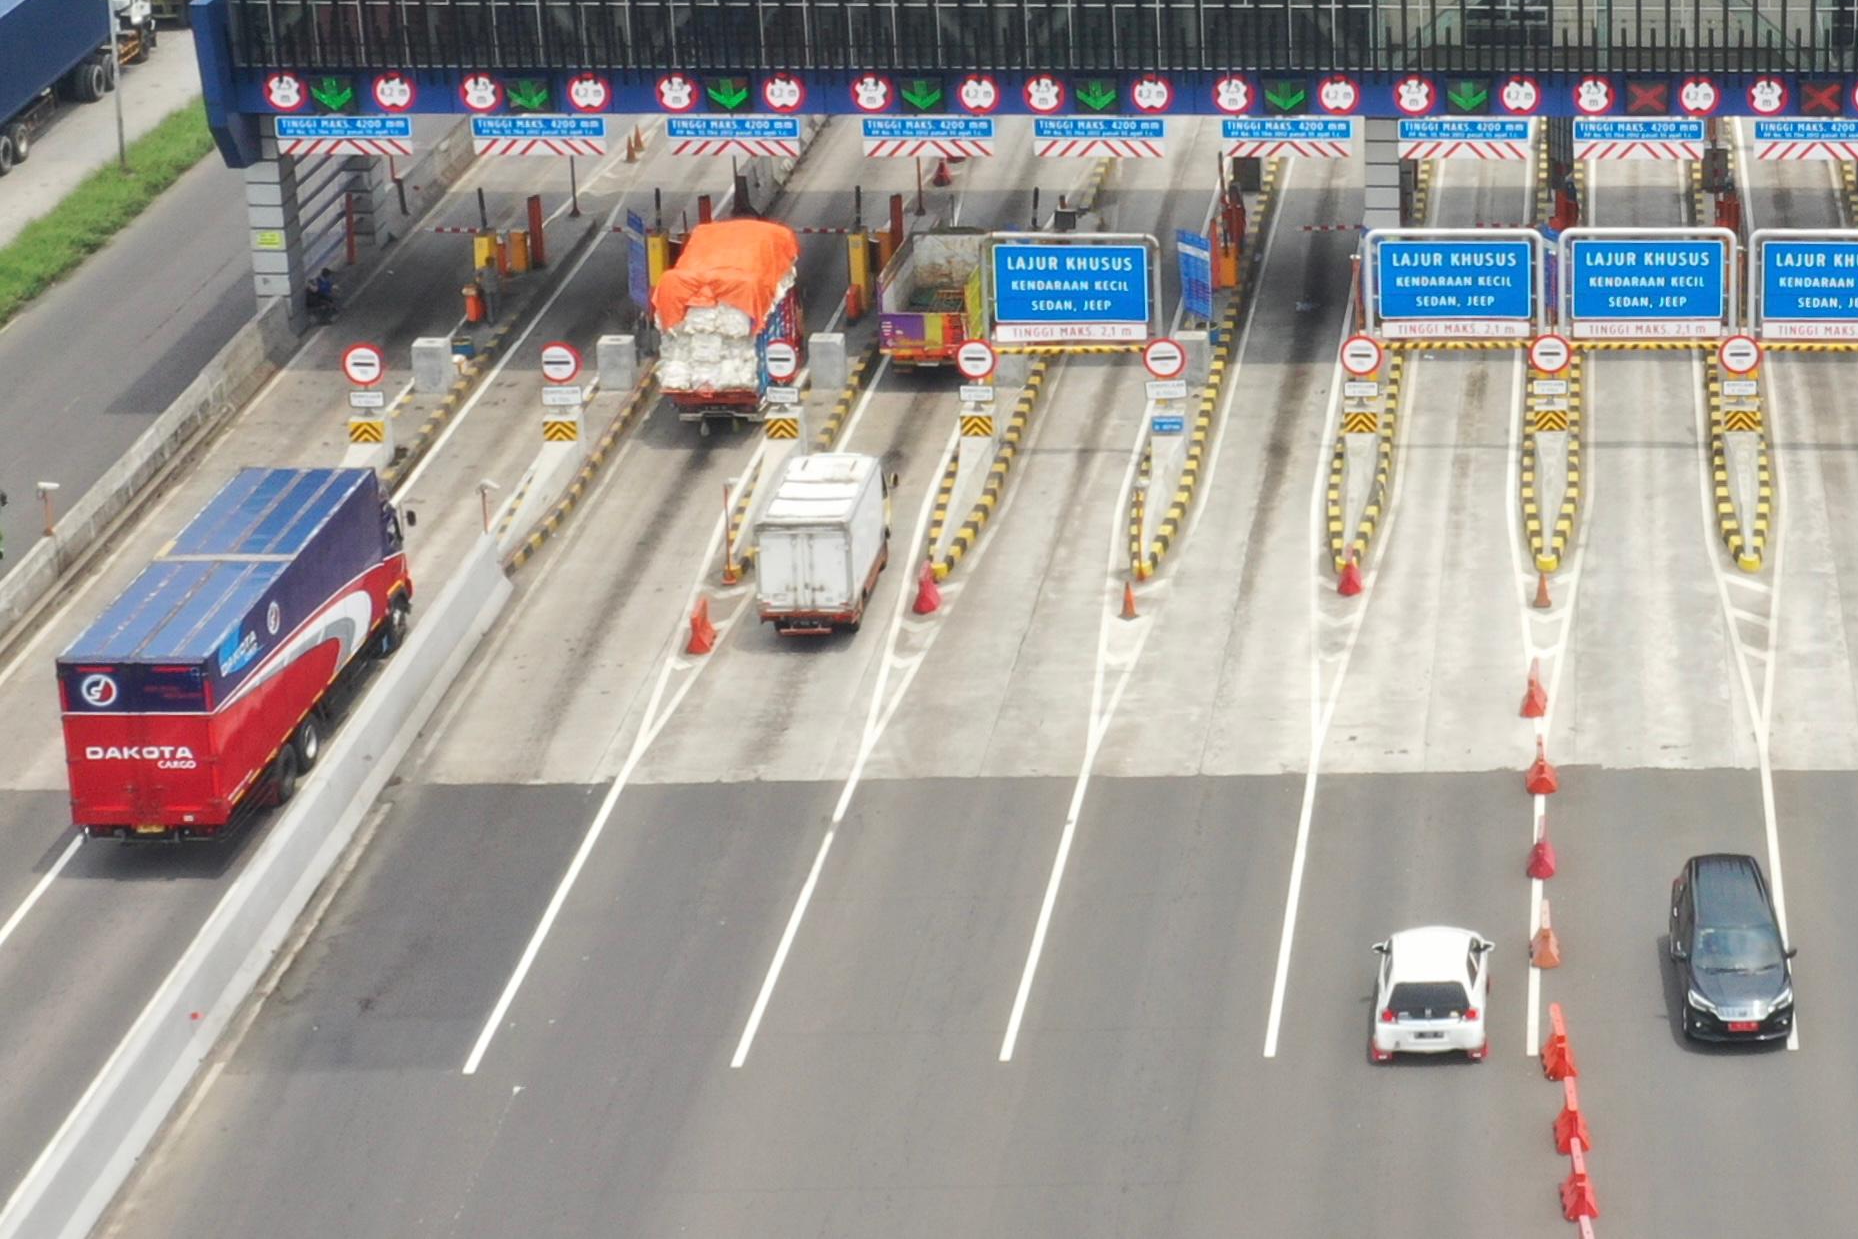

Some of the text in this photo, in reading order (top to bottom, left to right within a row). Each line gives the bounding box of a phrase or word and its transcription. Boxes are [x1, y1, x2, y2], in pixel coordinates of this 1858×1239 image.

[1155, 90, 1165, 98] m
[1343, 91, 1352, 99] m
[1523, 91, 1533, 99] m
[1702, 92, 1712, 100] m
[282, 120, 316, 128] TINGGI
[356, 119, 381, 128] 4200
[385, 120, 405, 128] mm
[479, 119, 512, 128] TINGGI
[551, 119, 576, 128] 4200
[581, 120, 599, 128] mm
[673, 120, 706, 129] TINGGI
[745, 120, 769, 129] 4200
[774, 121, 793, 129] mm
[867, 120, 901, 129] TINGGI
[941, 120, 965, 129] 4200
[1040, 120, 1073, 129] TINGGI
[1112, 120, 1136, 129] 4200
[1141, 121, 1160, 129] mm
[1228, 121, 1261, 130] TINGGI
[1299, 121, 1324, 130] 4200
[1404, 122, 1438, 132] TINGGI
[1477, 122, 1501, 131] 4200
[1506, 123, 1524, 131] mm
[1579, 122, 1613, 131] TINGGI
[1652, 122, 1676, 132] 4200
[1760, 122, 1793, 131] TINGGI
[1831, 122, 1855, 131] 4200
[1007, 257, 1132, 271] LAJUR KHUSUS
[1393, 253, 1516, 266] LAJUR KHUSUS
[1586, 252, 1709, 266] LAJUR KHUSUS
[1776, 253, 1826, 267] LAJUR
[1012, 280, 1128, 291] KENDARAAN KECIL
[1396, 276, 1511, 287] KENDARAAN KECIL
[1589, 276, 1703, 287] KENDARAAN KECIL
[1779, 277, 1854, 287] KENDARAAN
[1032, 300, 1111, 310] SEDAN, JEEP
[1416, 296, 1494, 306] SEDAN, JEEP
[1609, 296, 1687, 307] SEDAN, JEEP
[1798, 297, 1841, 308] SEDAN,
[1013, 328, 1054, 338] TINGGI
[1060, 328, 1095, 338] MAKS.
[1101, 327, 1116, 338] 2,1
[1398, 325, 1438, 334] TINGGI
[1444, 325, 1479, 334] MAKS.
[1485, 325, 1499, 335] 2,1
[1589, 325, 1629, 334] TINGGI
[1635, 325, 1669, 334] MAKS.
[1676, 324, 1690, 335] 2,1
[1778, 325, 1818, 335] TINGGI
[1824, 325, 1858, 335] MAKS.
[86, 746, 193, 760] DAKOTA
[158, 760, 197, 770] CARGO
